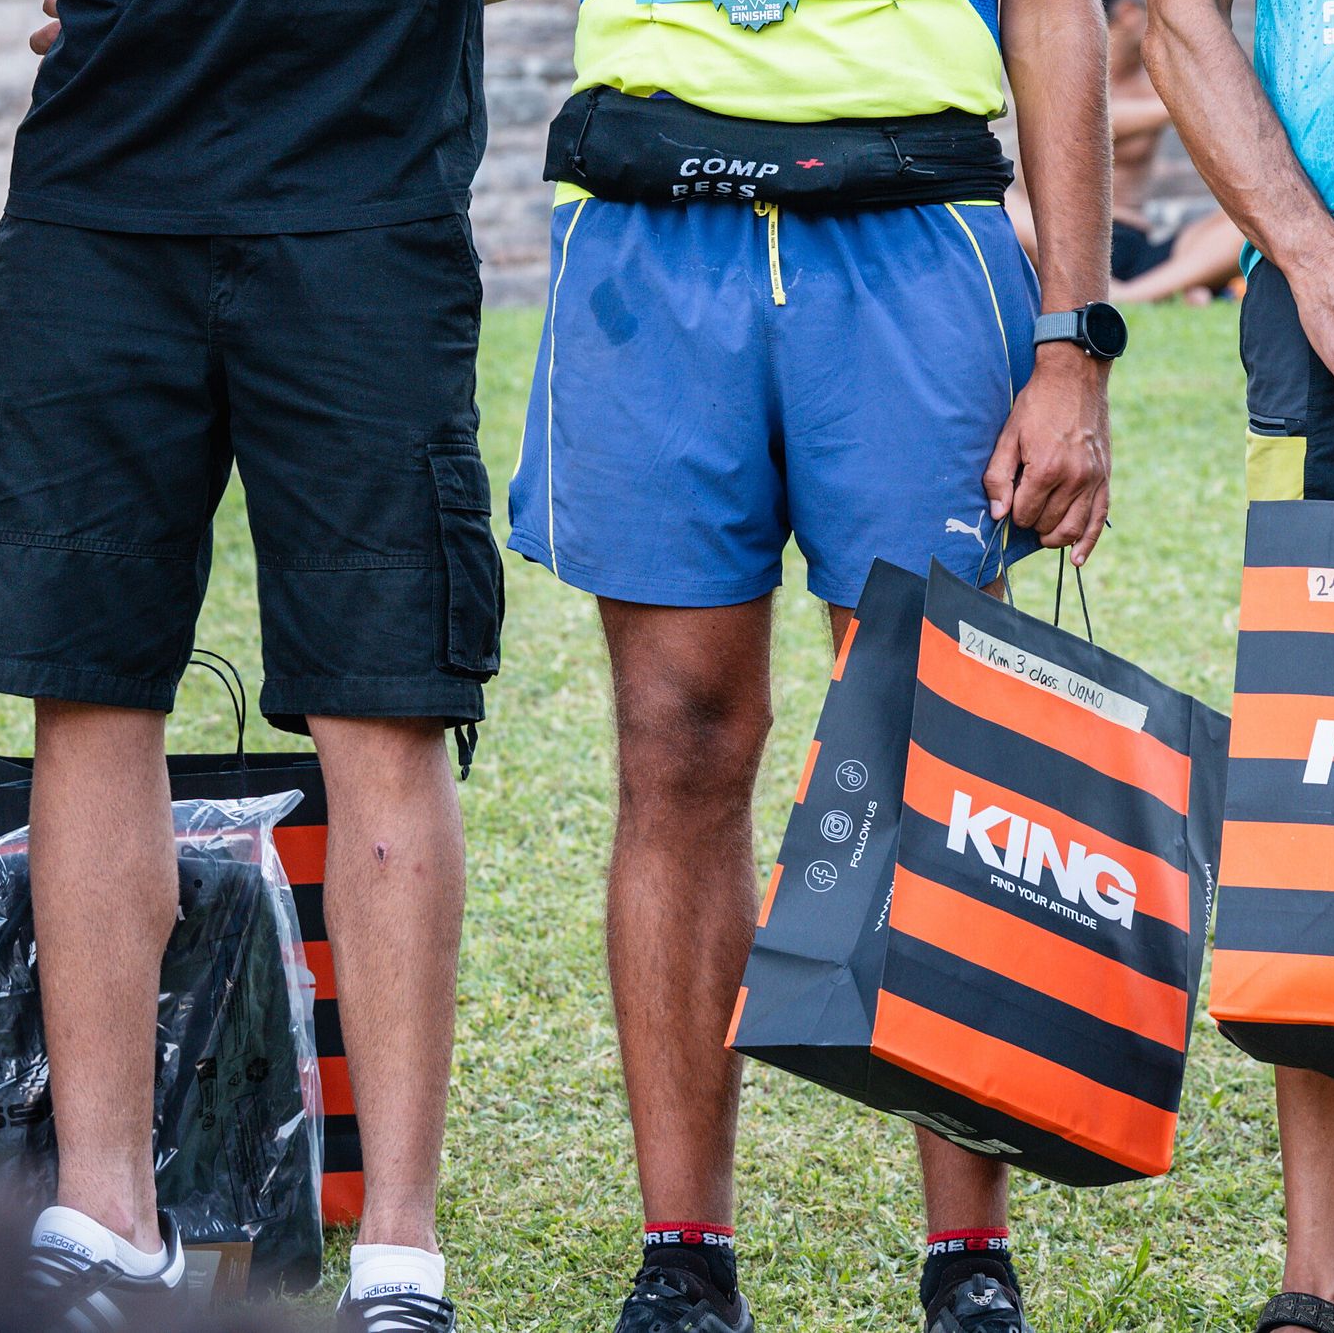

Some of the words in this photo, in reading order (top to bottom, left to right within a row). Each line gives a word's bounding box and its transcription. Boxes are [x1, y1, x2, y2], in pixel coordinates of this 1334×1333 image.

[731, 10, 780, 22] FINISHER
[680, 158, 779, 178] COMP
[672, 181, 756, 198] RESS
[966, 632, 984, 659] 21
[1014, 654, 1027, 674] 3
[850, 819, 873, 868] FOLLOW
[867, 800, 878, 818] US
[946, 789, 1137, 930] KING
[990, 873, 1016, 894] FIND
[1017, 883, 1049, 908] YOUR
[1049, 895, 1098, 931] ATTITUDE
[40, 1233, 77, 1253] adidas
[364, 1284, 402, 1298] adidas
